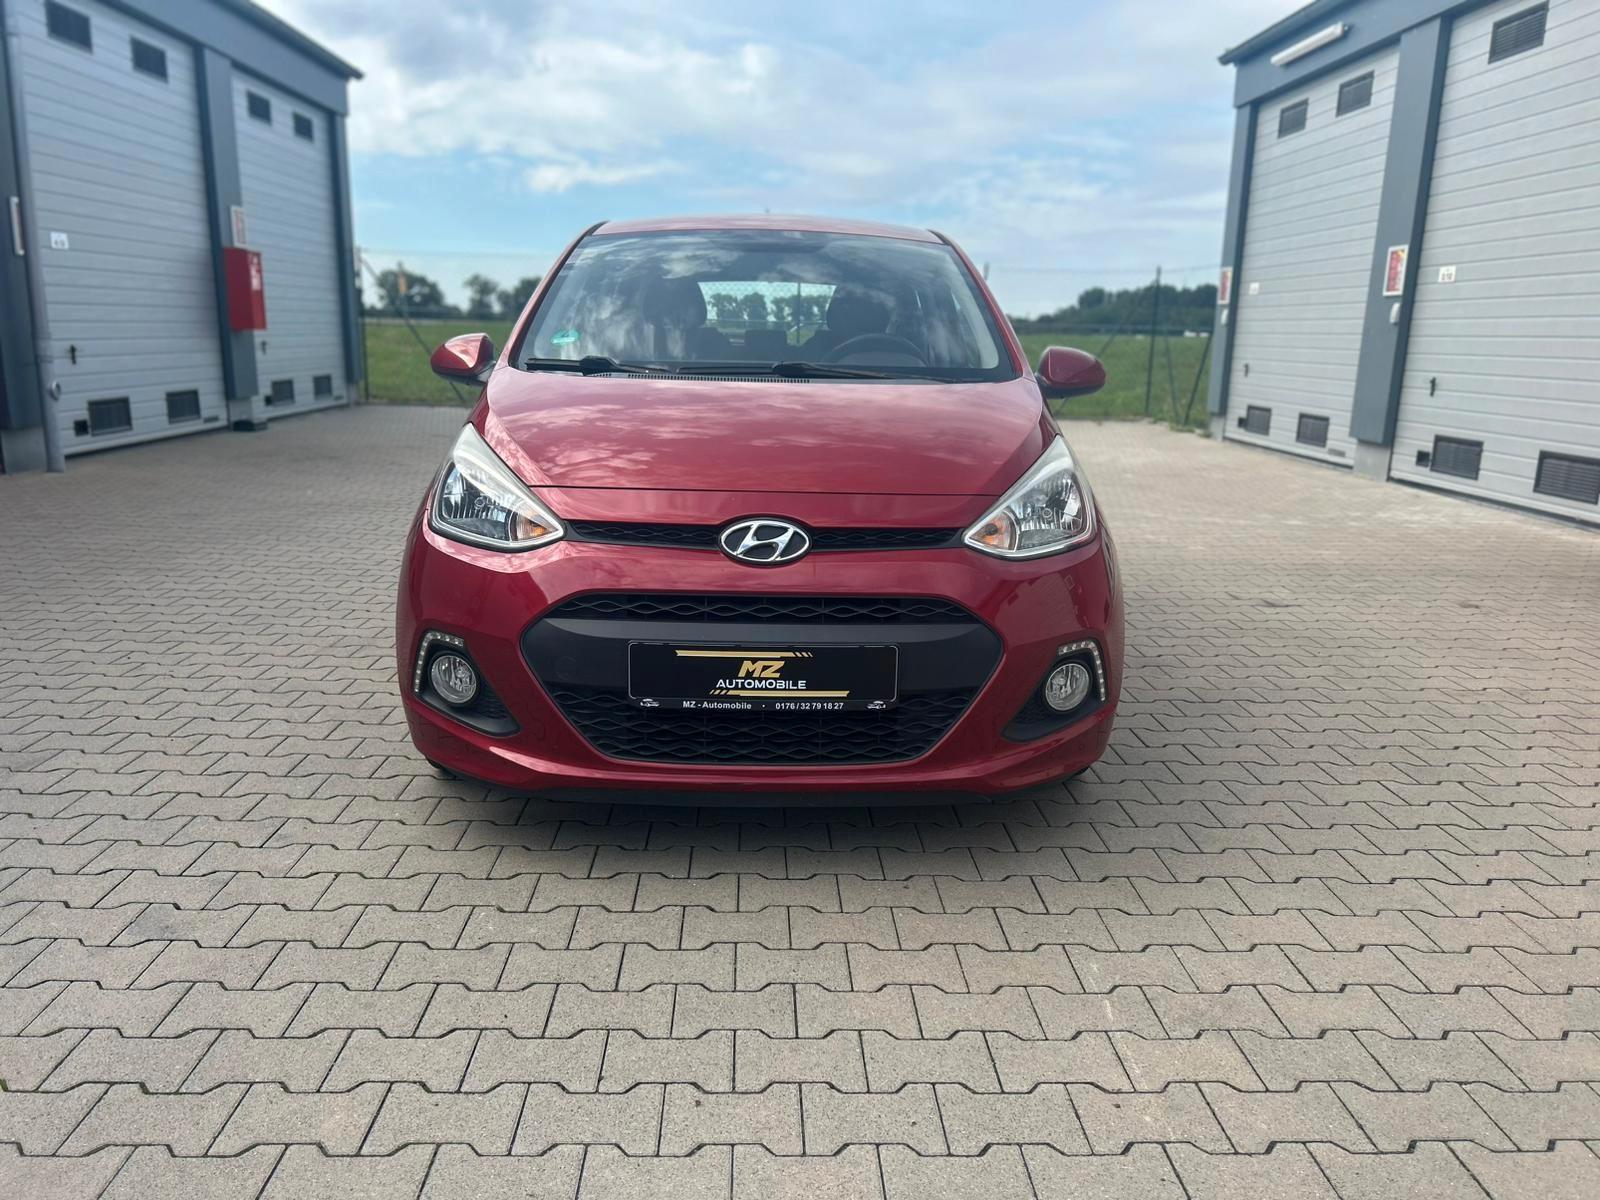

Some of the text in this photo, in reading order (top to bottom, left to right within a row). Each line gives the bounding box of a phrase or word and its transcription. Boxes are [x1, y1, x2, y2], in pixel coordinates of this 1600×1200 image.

[738, 660, 785, 678] MZ
[716, 679, 807, 690] AUTOMOBILE
[682, 701, 696, 709] MZ
[702, 701, 752, 710] Automobile
